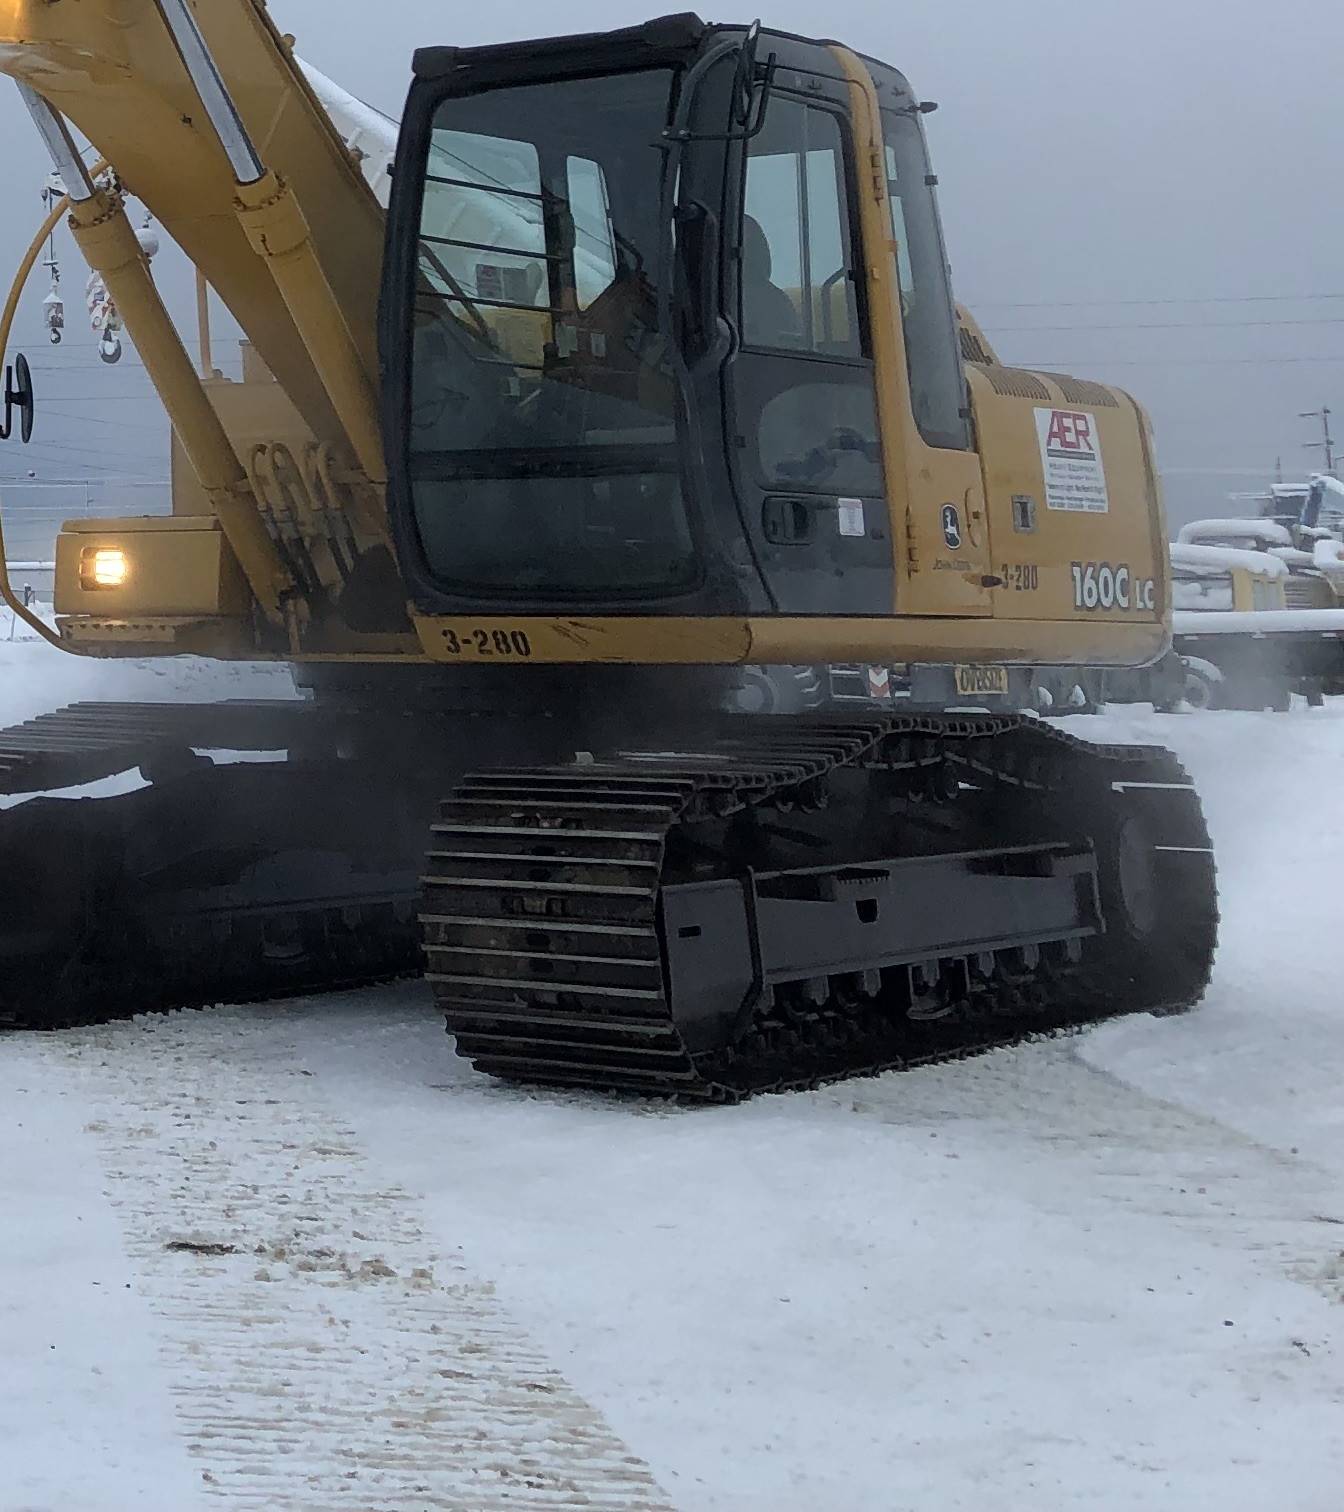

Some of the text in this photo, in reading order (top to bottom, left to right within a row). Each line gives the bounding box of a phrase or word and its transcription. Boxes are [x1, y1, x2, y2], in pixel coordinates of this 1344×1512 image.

[1047, 411, 1094, 451] AER
[1071, 563, 1155, 610] 160C LC
[441, 629, 532, 656] 3-280
